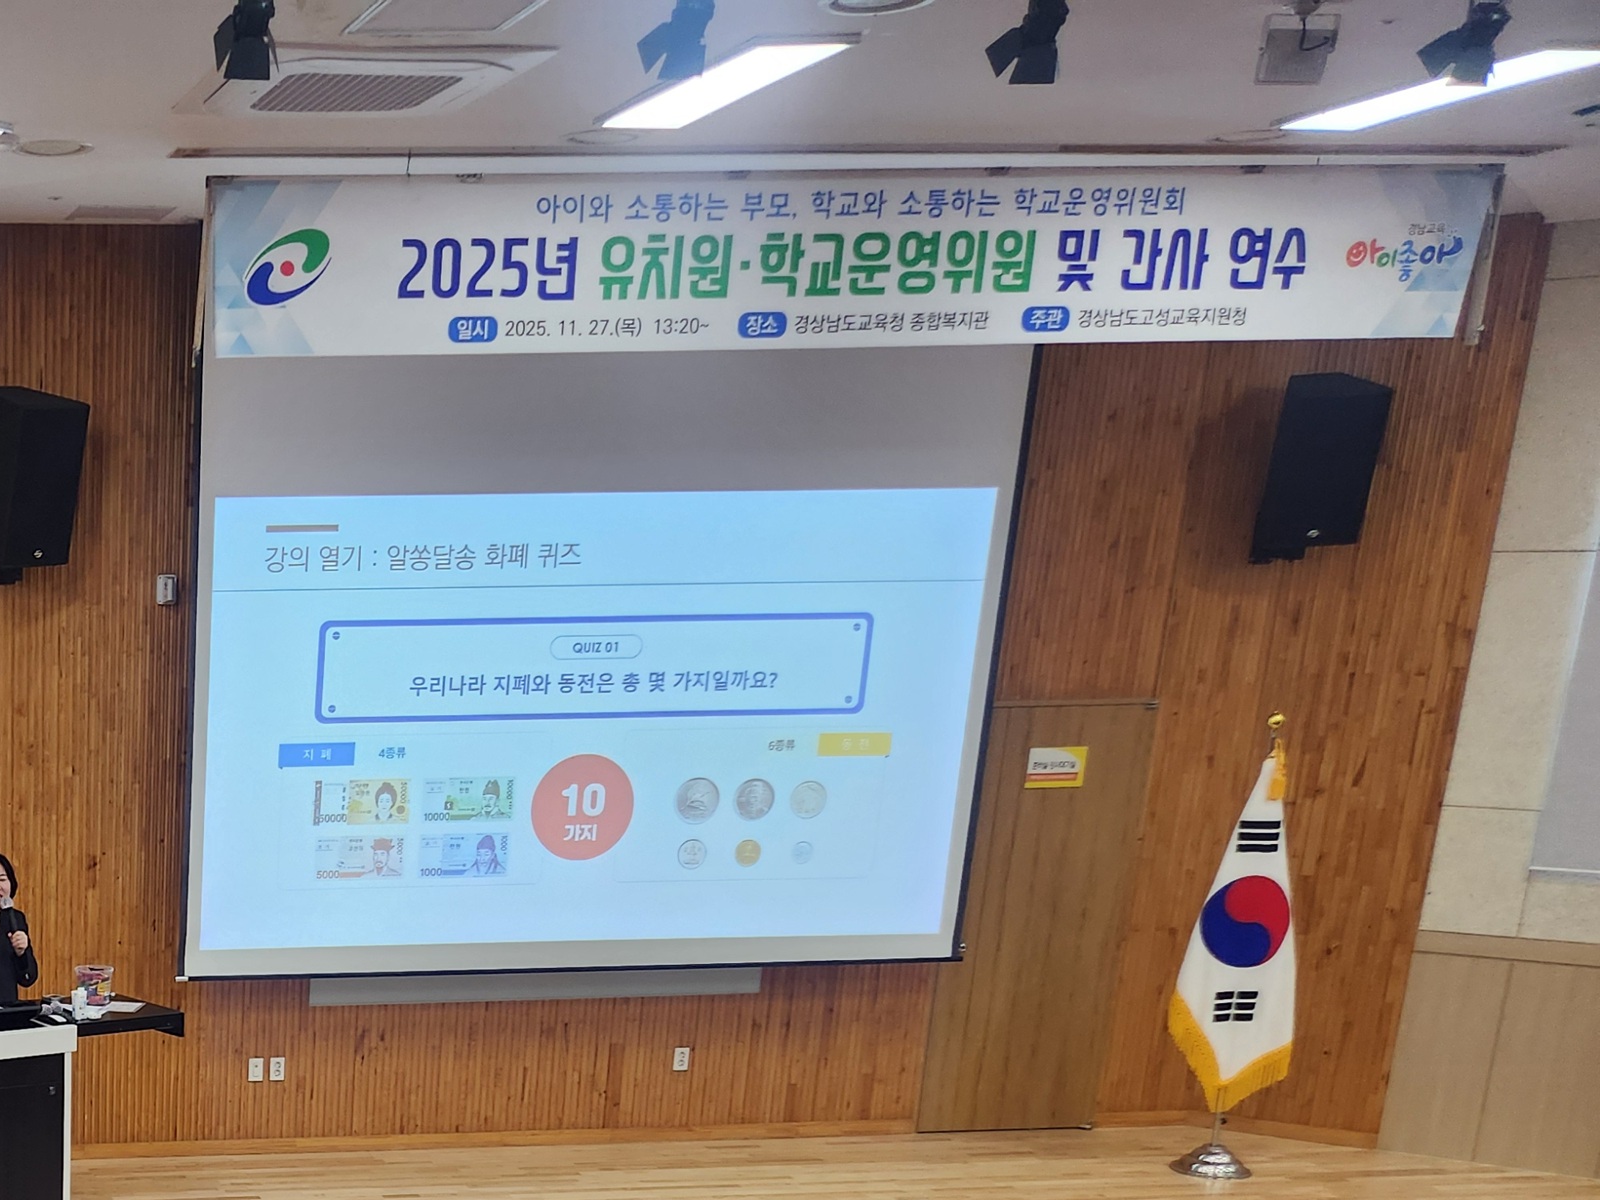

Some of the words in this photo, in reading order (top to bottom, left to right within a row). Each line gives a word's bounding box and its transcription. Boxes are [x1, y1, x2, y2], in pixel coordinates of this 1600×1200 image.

[536, 194, 613, 224] 아이와
[625, 192, 729, 223] 소통하는
[740, 191, 797, 222] 부모,
[811, 189, 887, 219] 학교와
[898, 188, 1001, 218] 소통하는
[1013, 187, 1187, 217] 학교운영위원회
[397, 236, 580, 300] 2025년
[599, 229, 1037, 301] 유치원·학교운영위원
[1056, 229, 1101, 292] 및
[1120, 227, 1210, 291] 간사
[1228, 227, 1308, 291] 연수
[456, 319, 490, 340] 일시
[505, 319, 551, 337] 2025.
[559, 319, 583, 337] 11.
[589, 316, 643, 338] 27.(목)
[654, 317, 710, 335] 13:20~
[745, 314, 779, 335] 장소
[793, 313, 905, 334] 경상남도교육청
[908, 311, 991, 332] 종합복지관
[1028, 308, 1064, 330] 주관
[1078, 306, 1248, 329] 경상남도고성교육지원청
[264, 545, 310, 573] 강의
[319, 544, 362, 572] 열기
[386, 543, 477, 572] 알쏭달송
[484, 542, 529, 569] 화폐
[537, 542, 582, 569] 퀴즈
[572, 641, 602, 655] QUIZ
[605, 641, 620, 654] 01
[409, 674, 486, 697] 우리나라
[493, 673, 552, 696] 지폐와
[557, 672, 615, 695] 동전은
[621, 672, 641, 693] 총
[648, 671, 666, 693] 몇
[673, 669, 779, 692] 가지일까요?
[378, 746, 406, 760] 4종류
[768, 739, 796, 752] 6종류
[561, 783, 606, 817] 10
[423, 812, 450, 821] 10000
[563, 823, 597, 841] 가지
[316, 870, 340, 879] 5000
[420, 867, 443, 877] 1000
